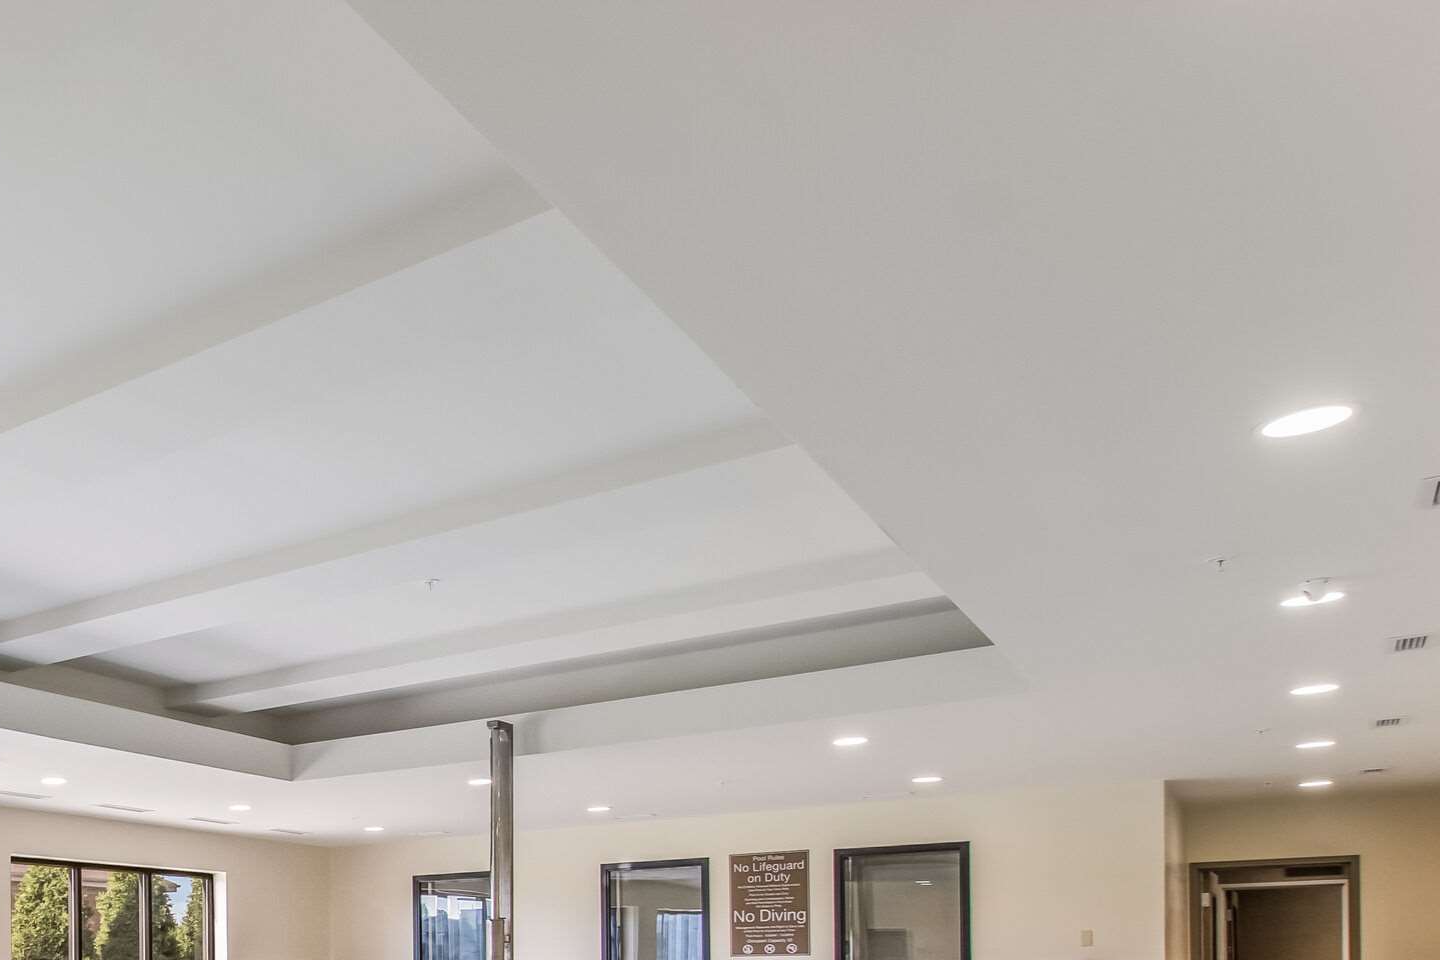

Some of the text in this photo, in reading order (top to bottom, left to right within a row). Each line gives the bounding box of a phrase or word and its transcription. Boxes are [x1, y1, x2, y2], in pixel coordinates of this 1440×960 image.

[734, 860, 804, 873] No Lifeguard
[747, 872, 791, 884] on Duty
[734, 908, 806, 924] No Diving
